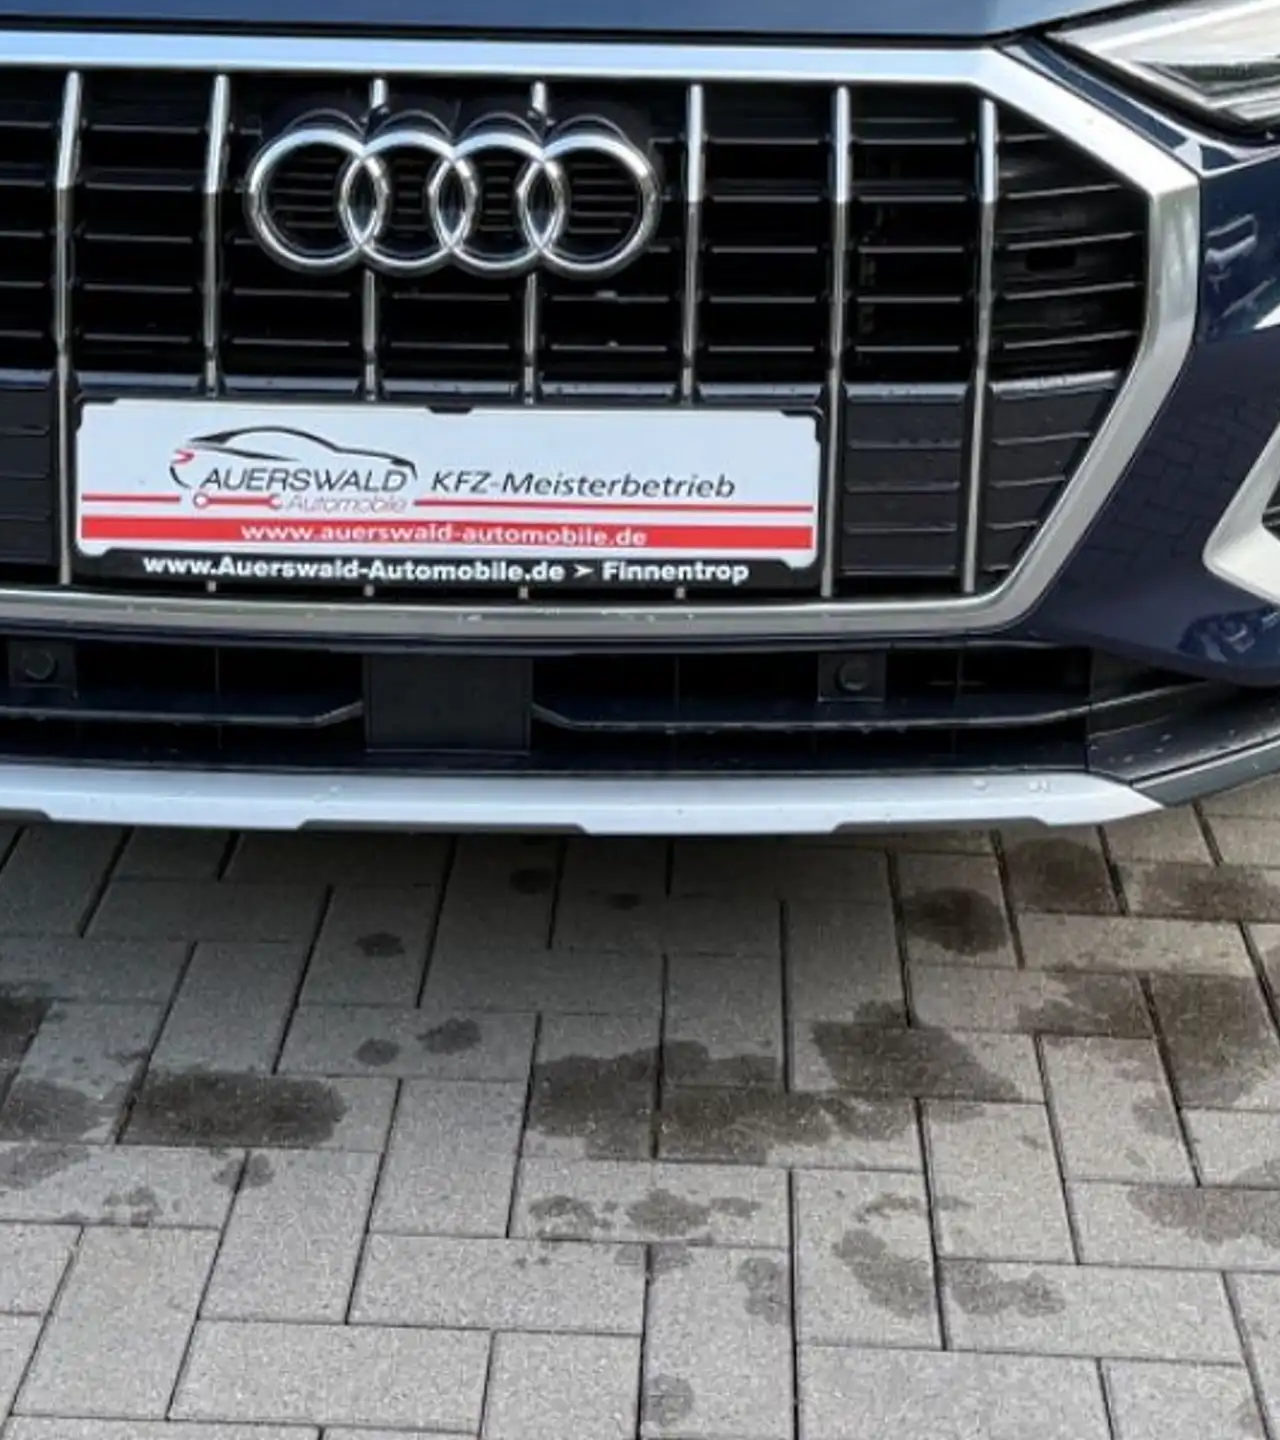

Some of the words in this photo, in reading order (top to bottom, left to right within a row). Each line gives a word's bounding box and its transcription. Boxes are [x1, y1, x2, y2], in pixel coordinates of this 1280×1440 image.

[200, 465, 409, 493] AUERSWALD
[430, 469, 737, 499] KFZ-Meisterbetrieb
[241, 519, 648, 547] www.auerswald-automobile.de
[142, 555, 566, 582] www.Auerswald-Automobile.de
[601, 561, 750, 586] Finnentrop
